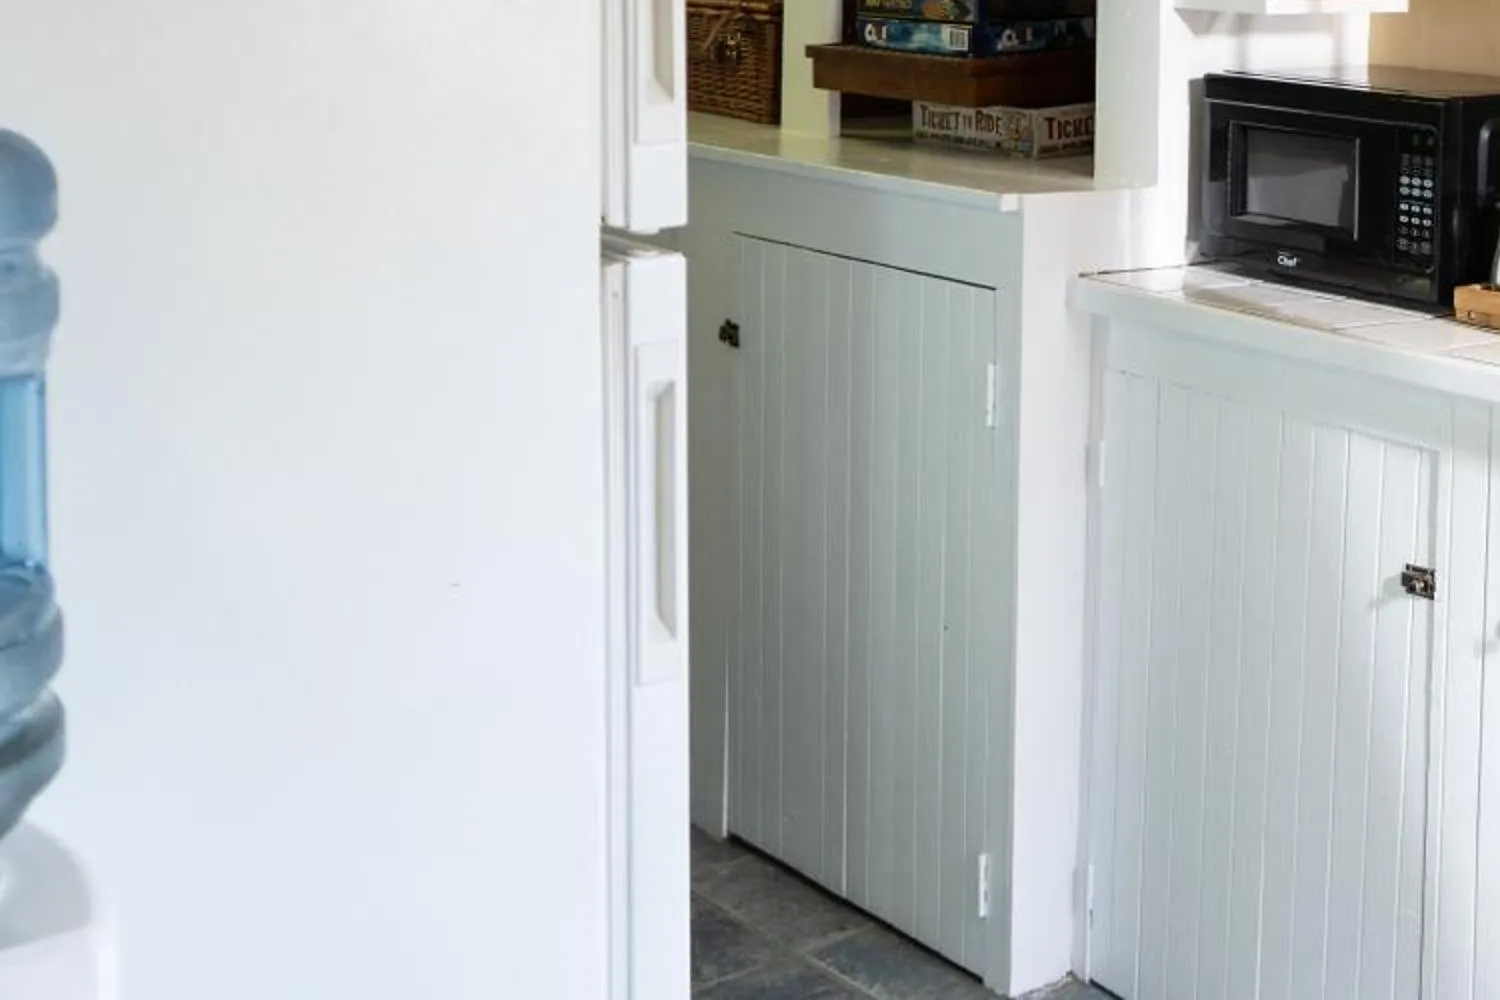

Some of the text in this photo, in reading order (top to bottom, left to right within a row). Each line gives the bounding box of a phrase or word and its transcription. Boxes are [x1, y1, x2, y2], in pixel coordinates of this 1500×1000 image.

[920, 103, 960, 131] TICKET
[975, 109, 1004, 135] RIDE
[1043, 114, 1095, 140] TICKE
